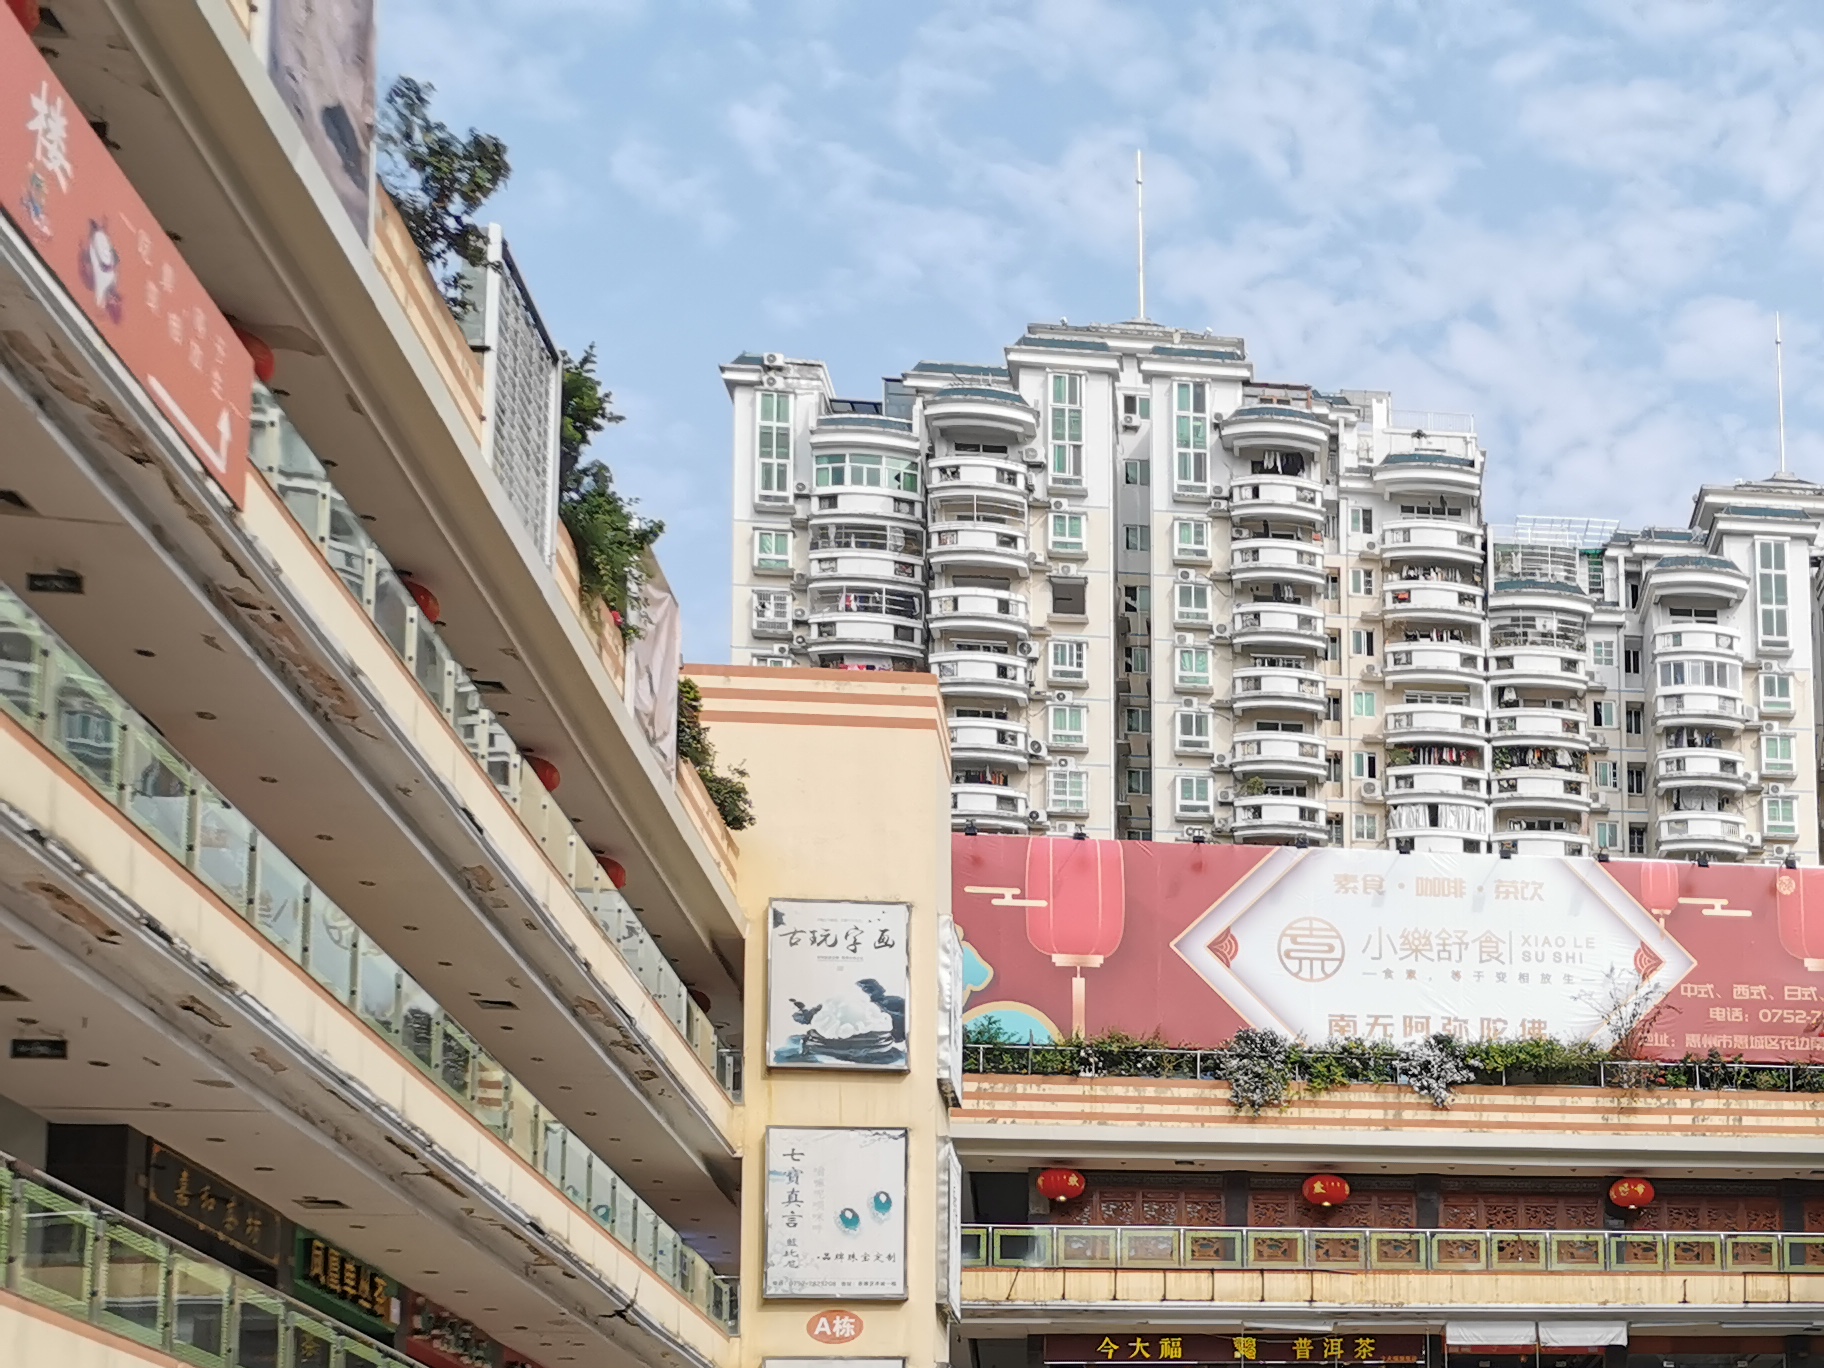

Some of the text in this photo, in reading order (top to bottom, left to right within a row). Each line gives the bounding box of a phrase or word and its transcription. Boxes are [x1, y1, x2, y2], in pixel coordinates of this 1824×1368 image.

[813, 1317, 855, 1338] A栋
[1095, 1336, 1376, 1360] 今大福 普洱茶
